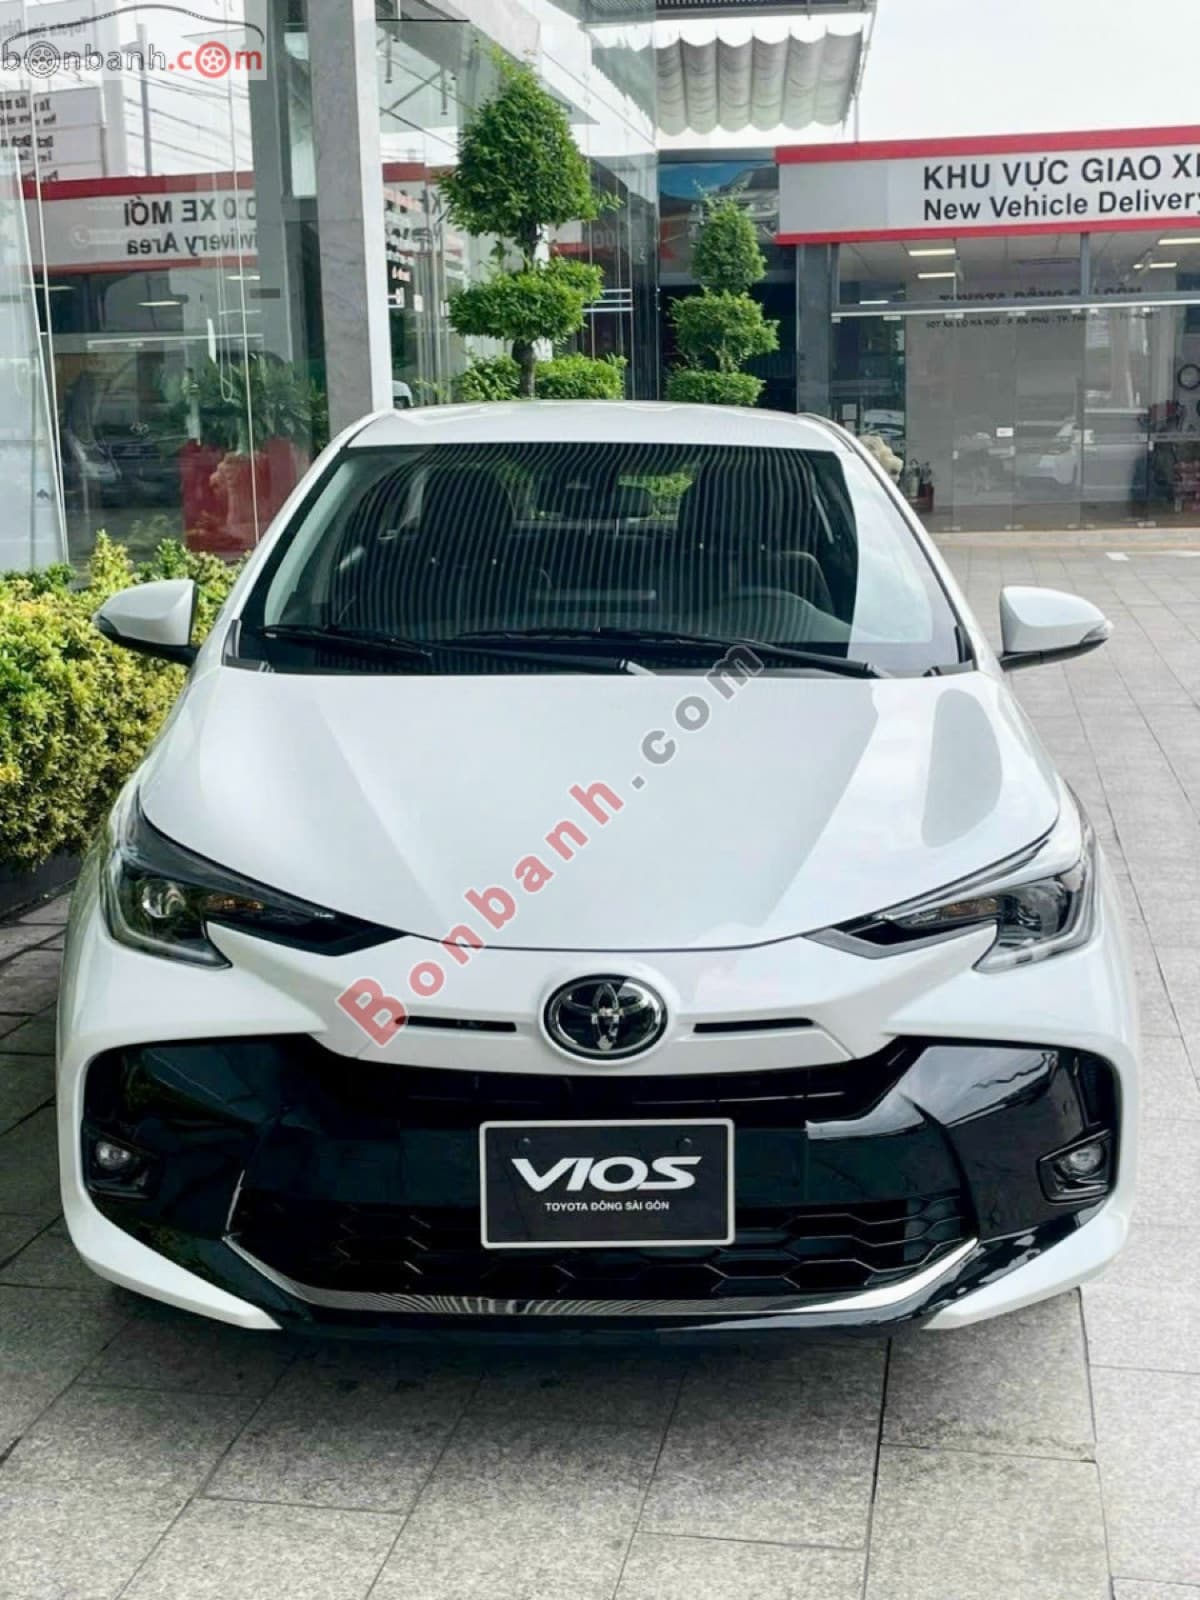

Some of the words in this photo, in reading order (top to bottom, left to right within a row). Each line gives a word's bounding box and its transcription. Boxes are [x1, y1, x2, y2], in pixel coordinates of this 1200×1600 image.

[924, 163, 990, 190] KHU
[1002, 157, 1069, 191] VỰC
[1081, 155, 1161, 183] GIAO
[1172, 152, 1200, 179] X
[924, 198, 981, 221] New
[990, 193, 1088, 218] Vehicle
[1099, 188, 1200, 216] Deliver
[511, 1156, 702, 1192] VIOS
[545, 1202, 589, 1212] TOYOTA
